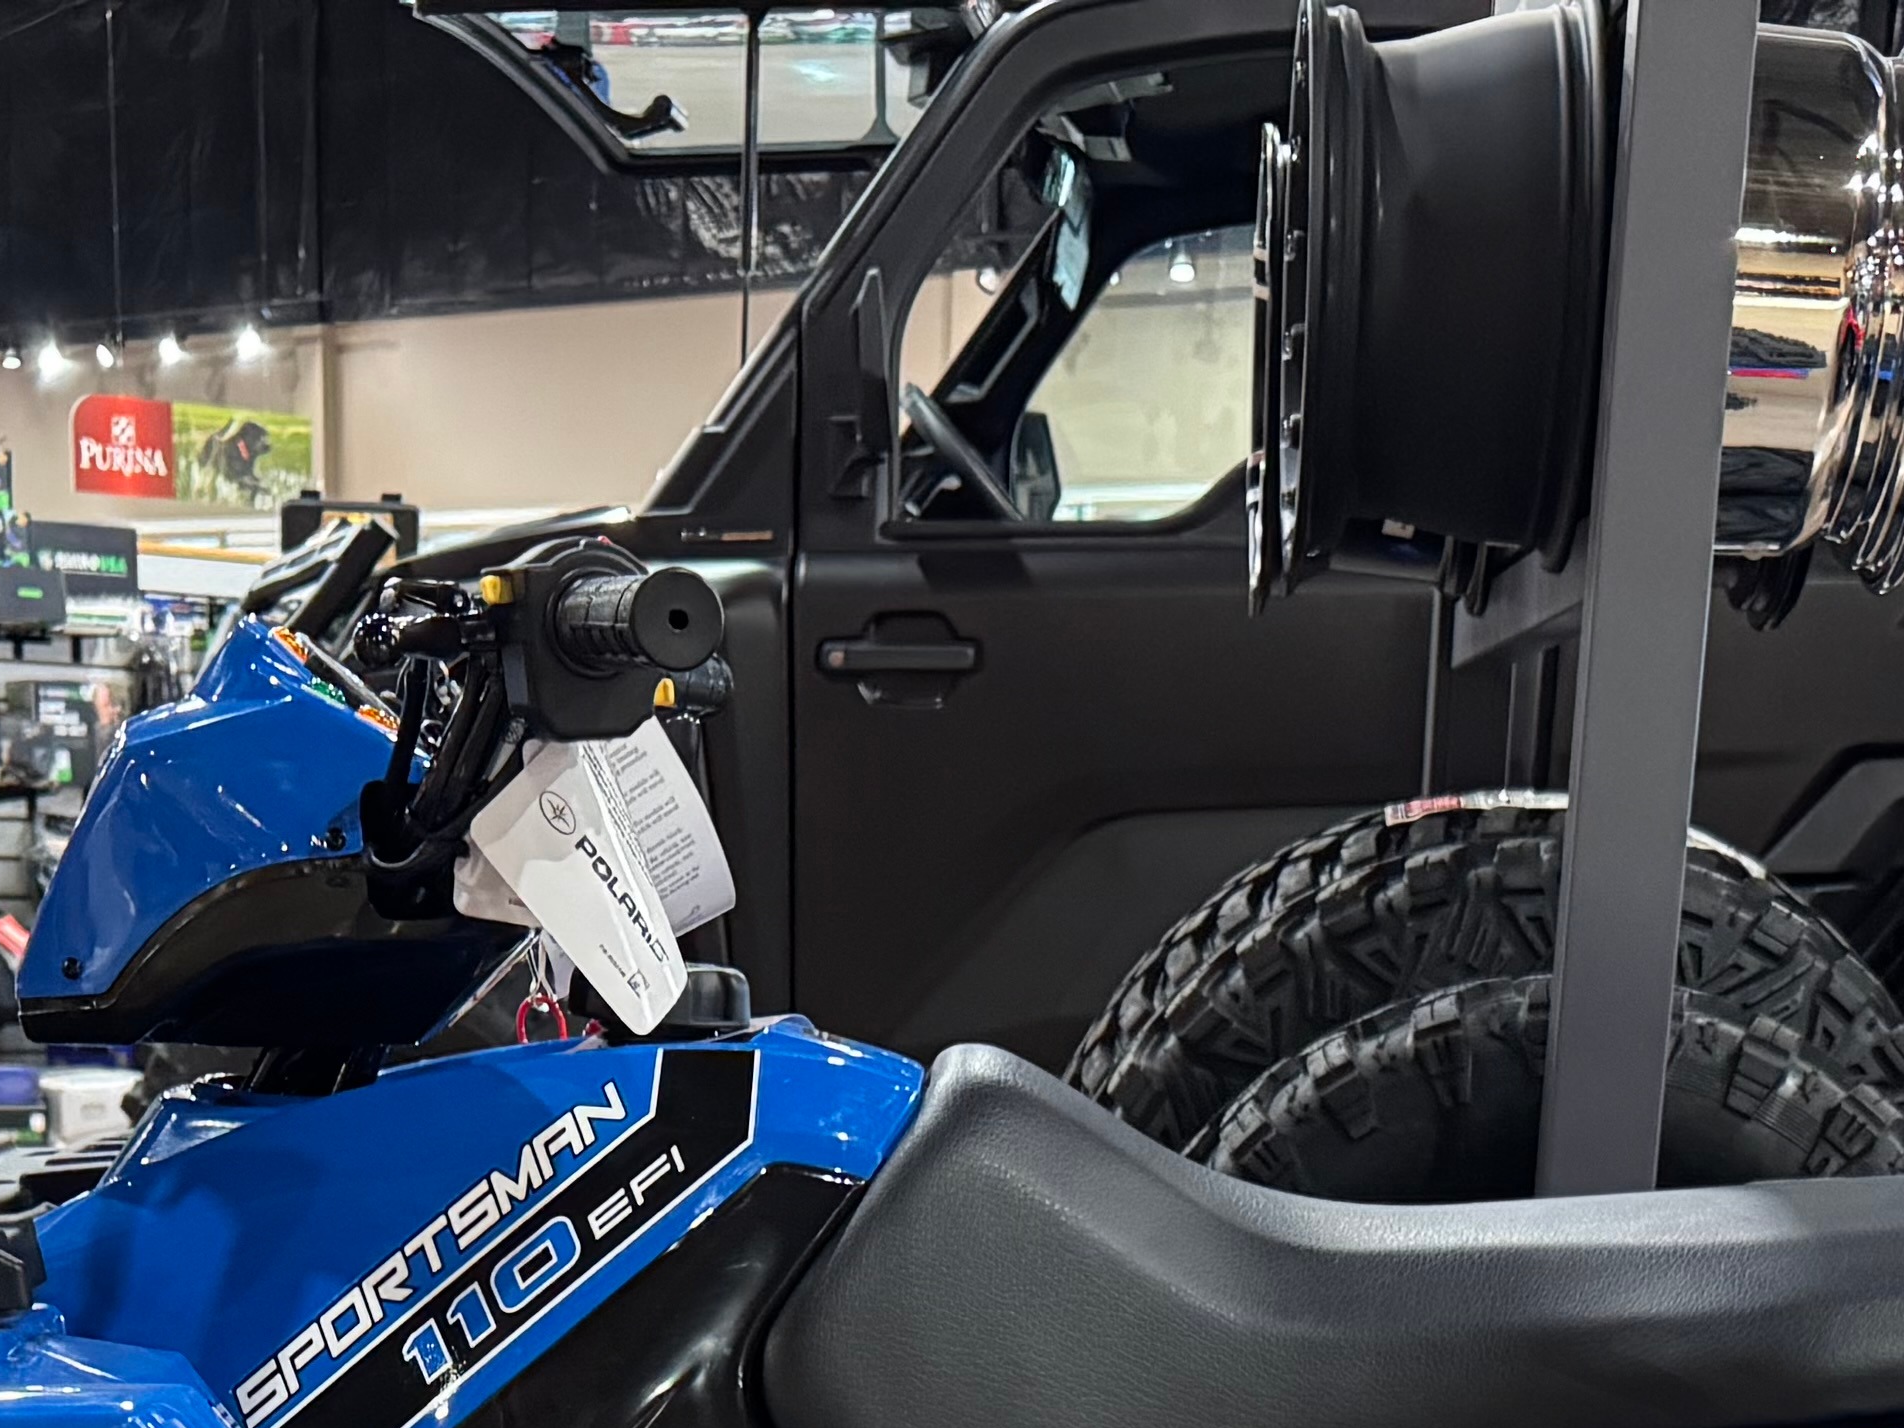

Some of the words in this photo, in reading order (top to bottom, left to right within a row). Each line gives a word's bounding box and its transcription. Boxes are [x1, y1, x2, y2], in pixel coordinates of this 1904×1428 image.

[79, 435, 168, 477] PURINA
[402, 1214, 582, 1385] 110
[590, 1144, 685, 1237] EFI
